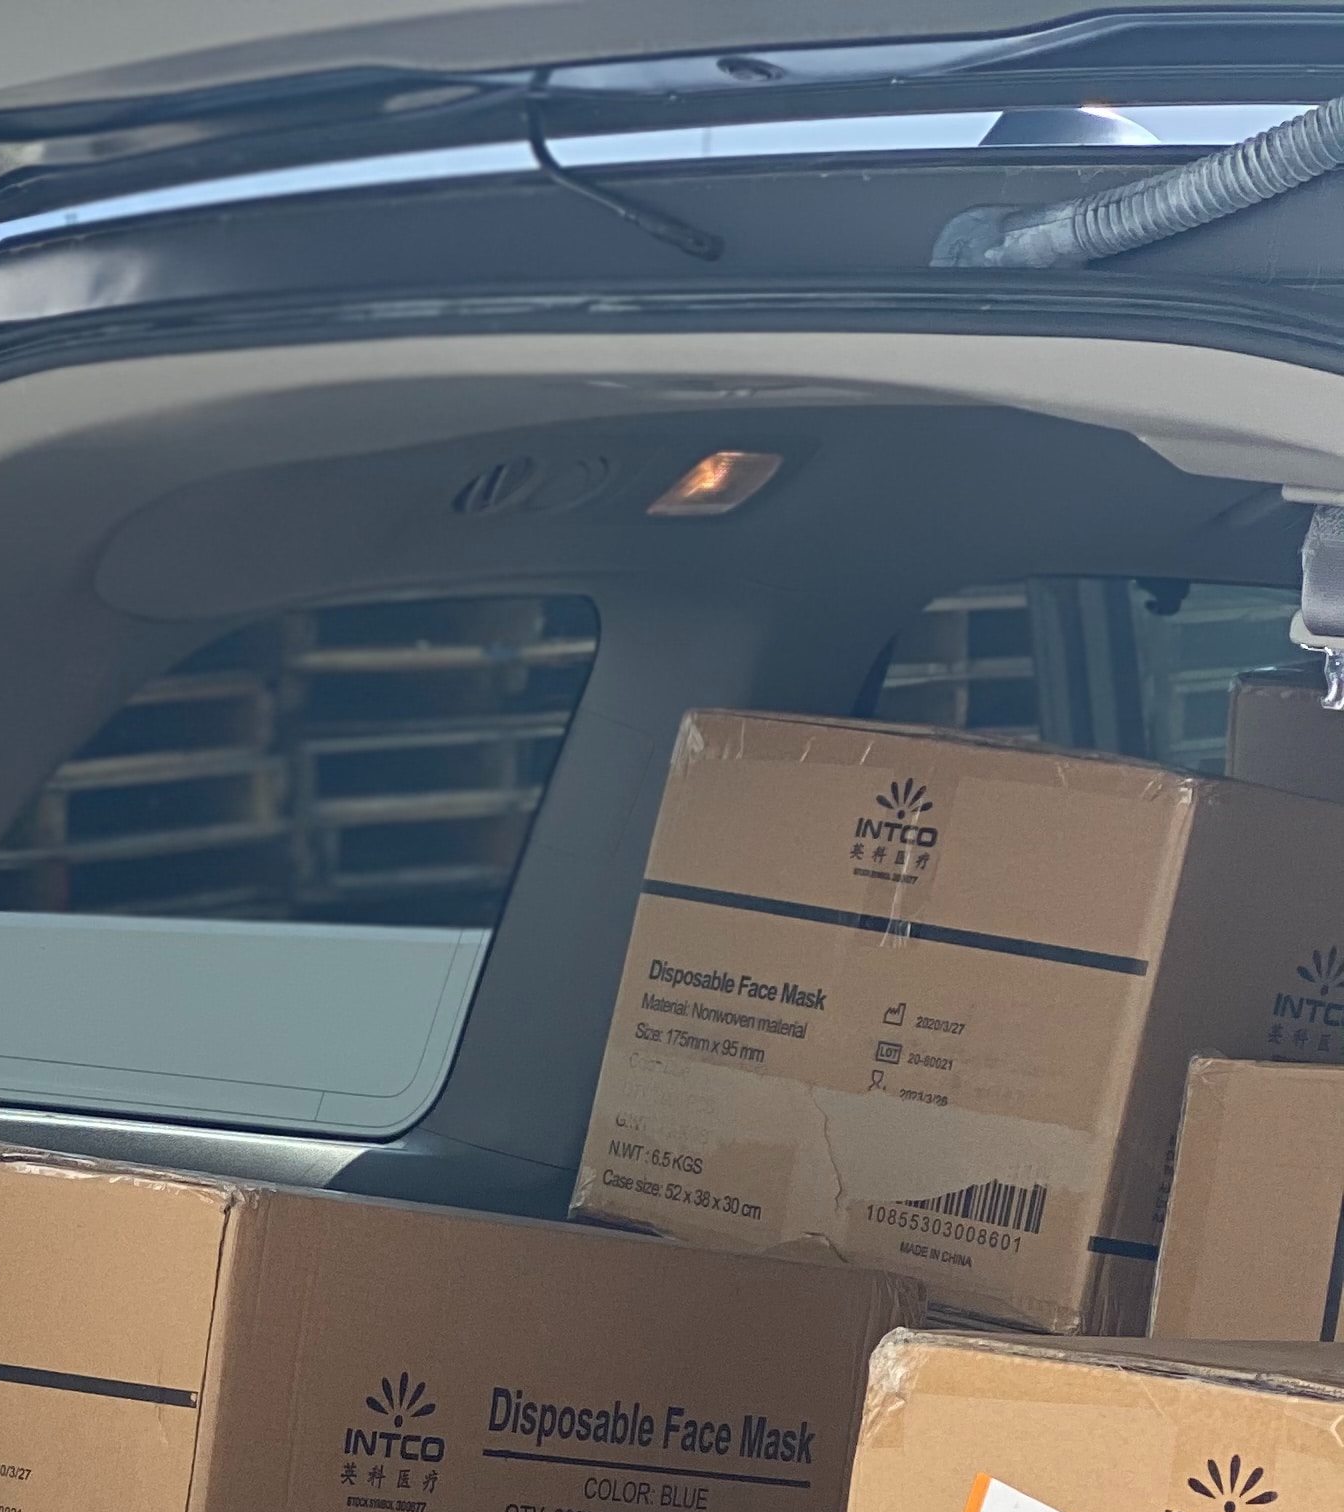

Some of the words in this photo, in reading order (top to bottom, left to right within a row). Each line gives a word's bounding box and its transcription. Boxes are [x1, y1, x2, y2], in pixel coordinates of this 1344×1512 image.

[854, 816, 938, 848] INTCO
[648, 958, 735, 994] Disposable
[736, 974, 778, 1001] Face
[779, 981, 827, 1011] Mask
[866, 1203, 1021, 1253] 10855303008601
[899, 1240, 929, 1258] MADE
[929, 1248, 941, 1260] IN
[940, 1250, 972, 1268] CHINA
[487, 1386, 654, 1447] Disposable
[661, 1405, 731, 1455] Face
[738, 1414, 816, 1464] Mask
[343, 1427, 445, 1463] INTCO
[583, 1476, 655, 1505] COLOR:
[659, 1484, 709, 1510] BLUE
